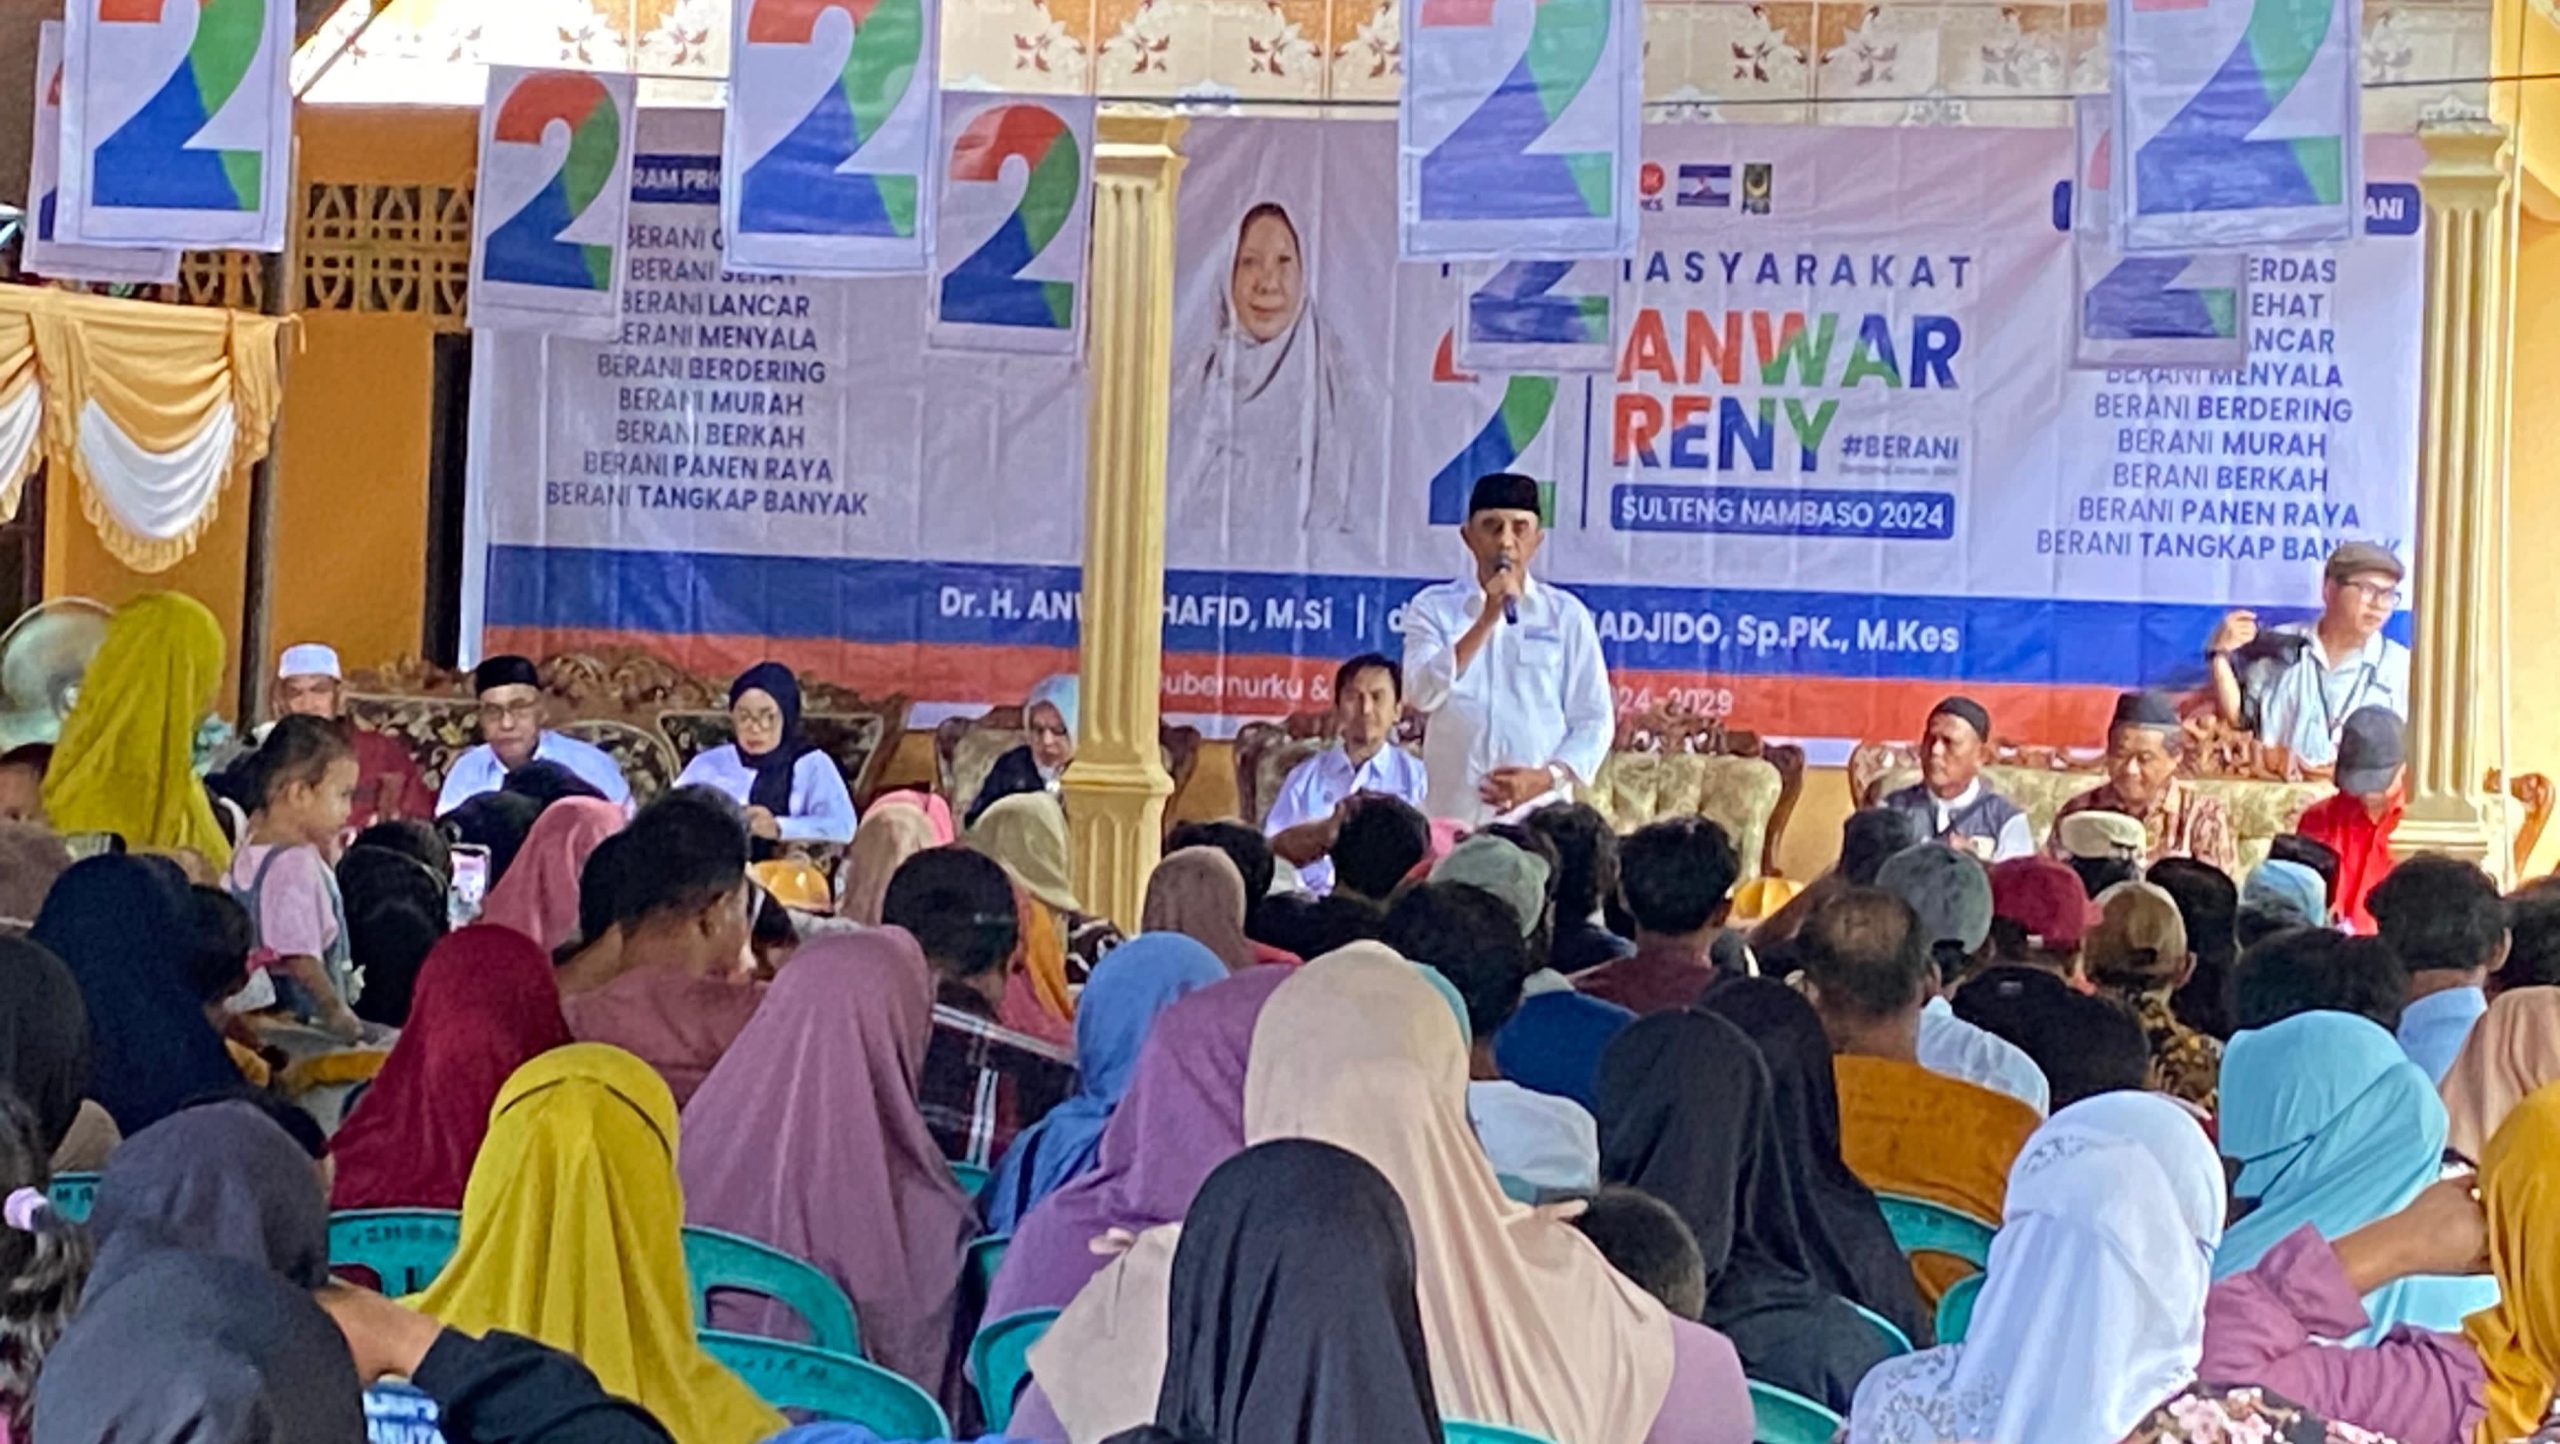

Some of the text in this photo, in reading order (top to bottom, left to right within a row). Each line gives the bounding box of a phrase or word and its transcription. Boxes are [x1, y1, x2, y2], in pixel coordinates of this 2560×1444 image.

[92, 0, 265, 212] 2
[739, 0, 923, 238] 2
[1420, 0, 1613, 220] 2
[2134, 0, 2343, 216] 2
[480, 69, 621, 292] 2
[941, 104, 1081, 329] 2
[2364, 197, 2405, 220] ANI
[632, 257, 715, 281] BERANI
[1622, 250, 1972, 289] ASYARAKAT
[2249, 257, 2336, 283] ERDAS
[709, 294, 810, 317] LANCAR
[2252, 293, 2324, 318] EHAT
[609, 321, 818, 351] ERANI MENYALA
[1617, 309, 1961, 389] ANWAR
[599, 353, 825, 383] BERANI BERDERING
[619, 387, 803, 415] BERANI MURAH
[2095, 394, 2353, 422] BERANI BERDERING
[616, 420, 804, 447] BERANI BERKAH
[1612, 394, 1839, 471] RENY
[1841, 434, 1958, 459] #BERANI
[2119, 429, 2326, 457] BERANI MURAH
[584, 451, 833, 483] BERANI PANEN RAYA
[2113, 463, 2327, 492] BERANI BERKAH
[546, 483, 868, 516] BERANI TANGKAP BANYAK
[1621, 495, 1945, 529] SULTENG NAMBASO 2024
[2079, 497, 2360, 528] BERANI PANEN RAYA
[2037, 530, 2131, 555] BERANI
[2141, 532, 2274, 559] TANGKAP
[941, 586, 985, 617] Dr.
[991, 589, 1022, 619] H.
[1265, 597, 1333, 631] M.Si
[1592, 609, 1730, 651] ADJIDO,
[1737, 613, 1848, 657] Sp.PK.,
[1858, 618, 1960, 653] M.Kes
[1161, 671, 1330, 700] ubernurku &
